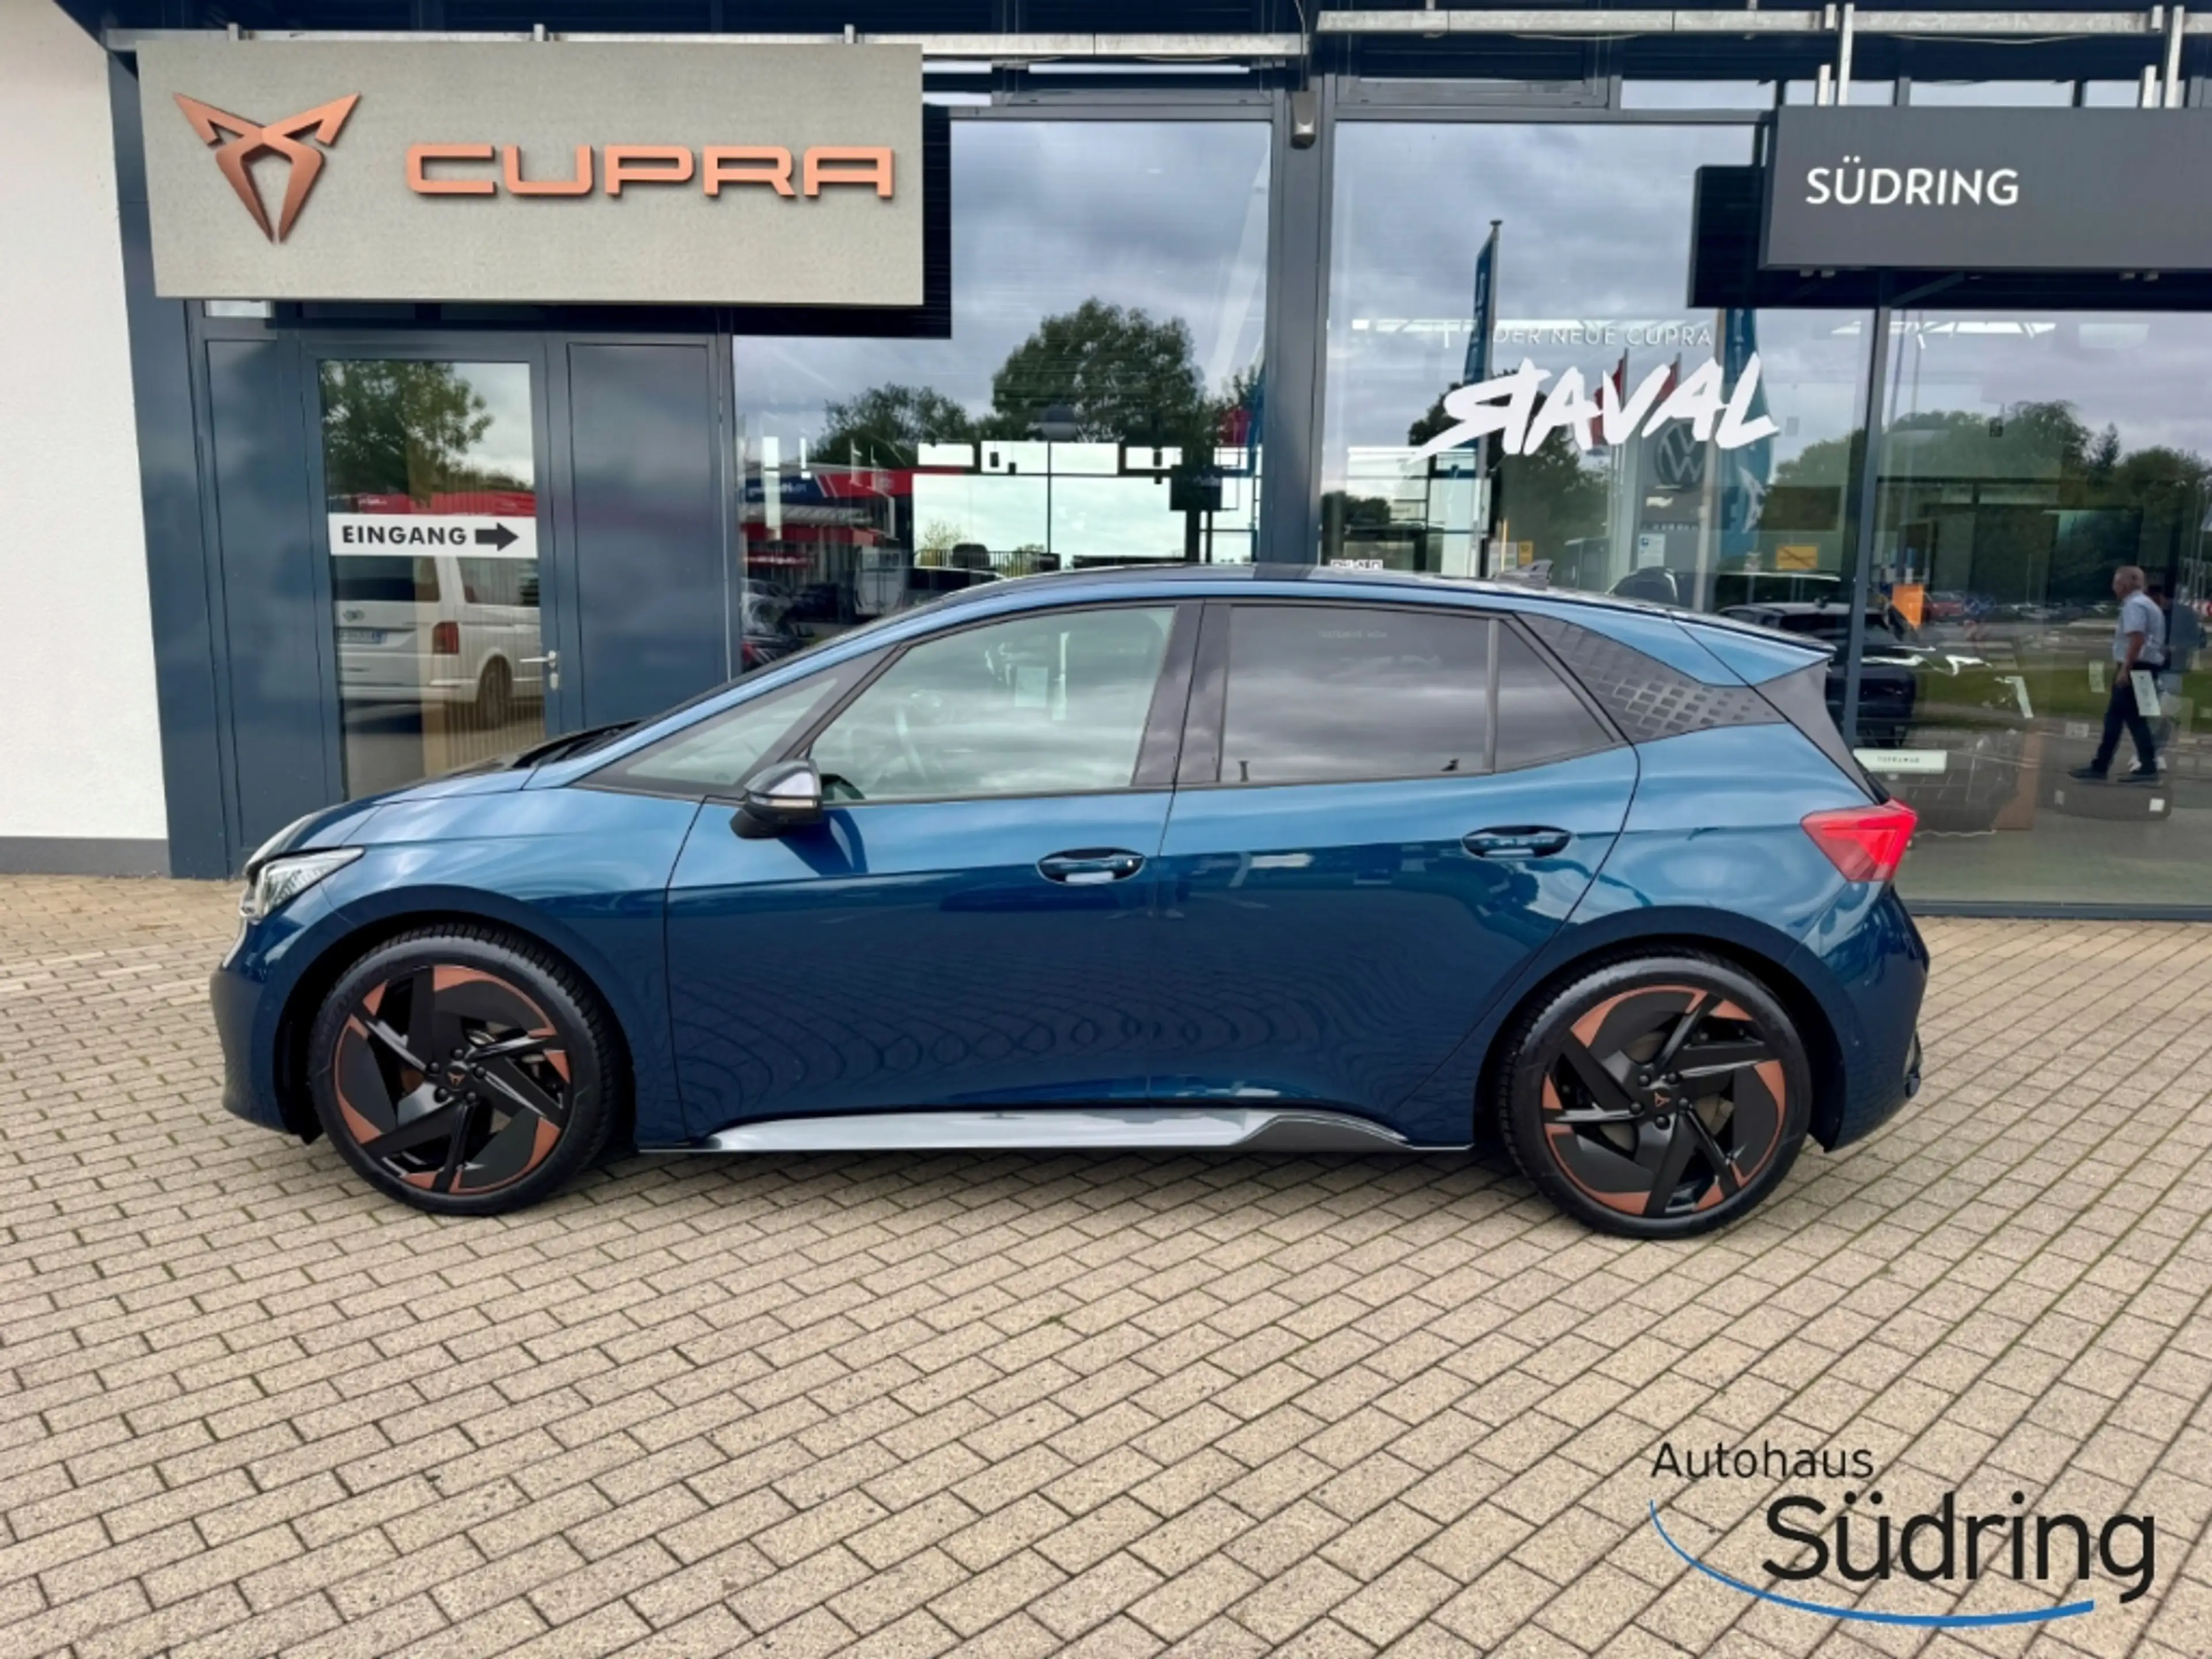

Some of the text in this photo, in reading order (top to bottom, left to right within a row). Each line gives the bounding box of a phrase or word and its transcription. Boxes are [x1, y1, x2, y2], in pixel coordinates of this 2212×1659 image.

[406, 143, 894, 197] CUPRA
[1805, 156, 2019, 206] SÜDRING
[1493, 326, 1713, 346] DER NEUE CUPRA
[342, 525, 467, 545] EINGANG
